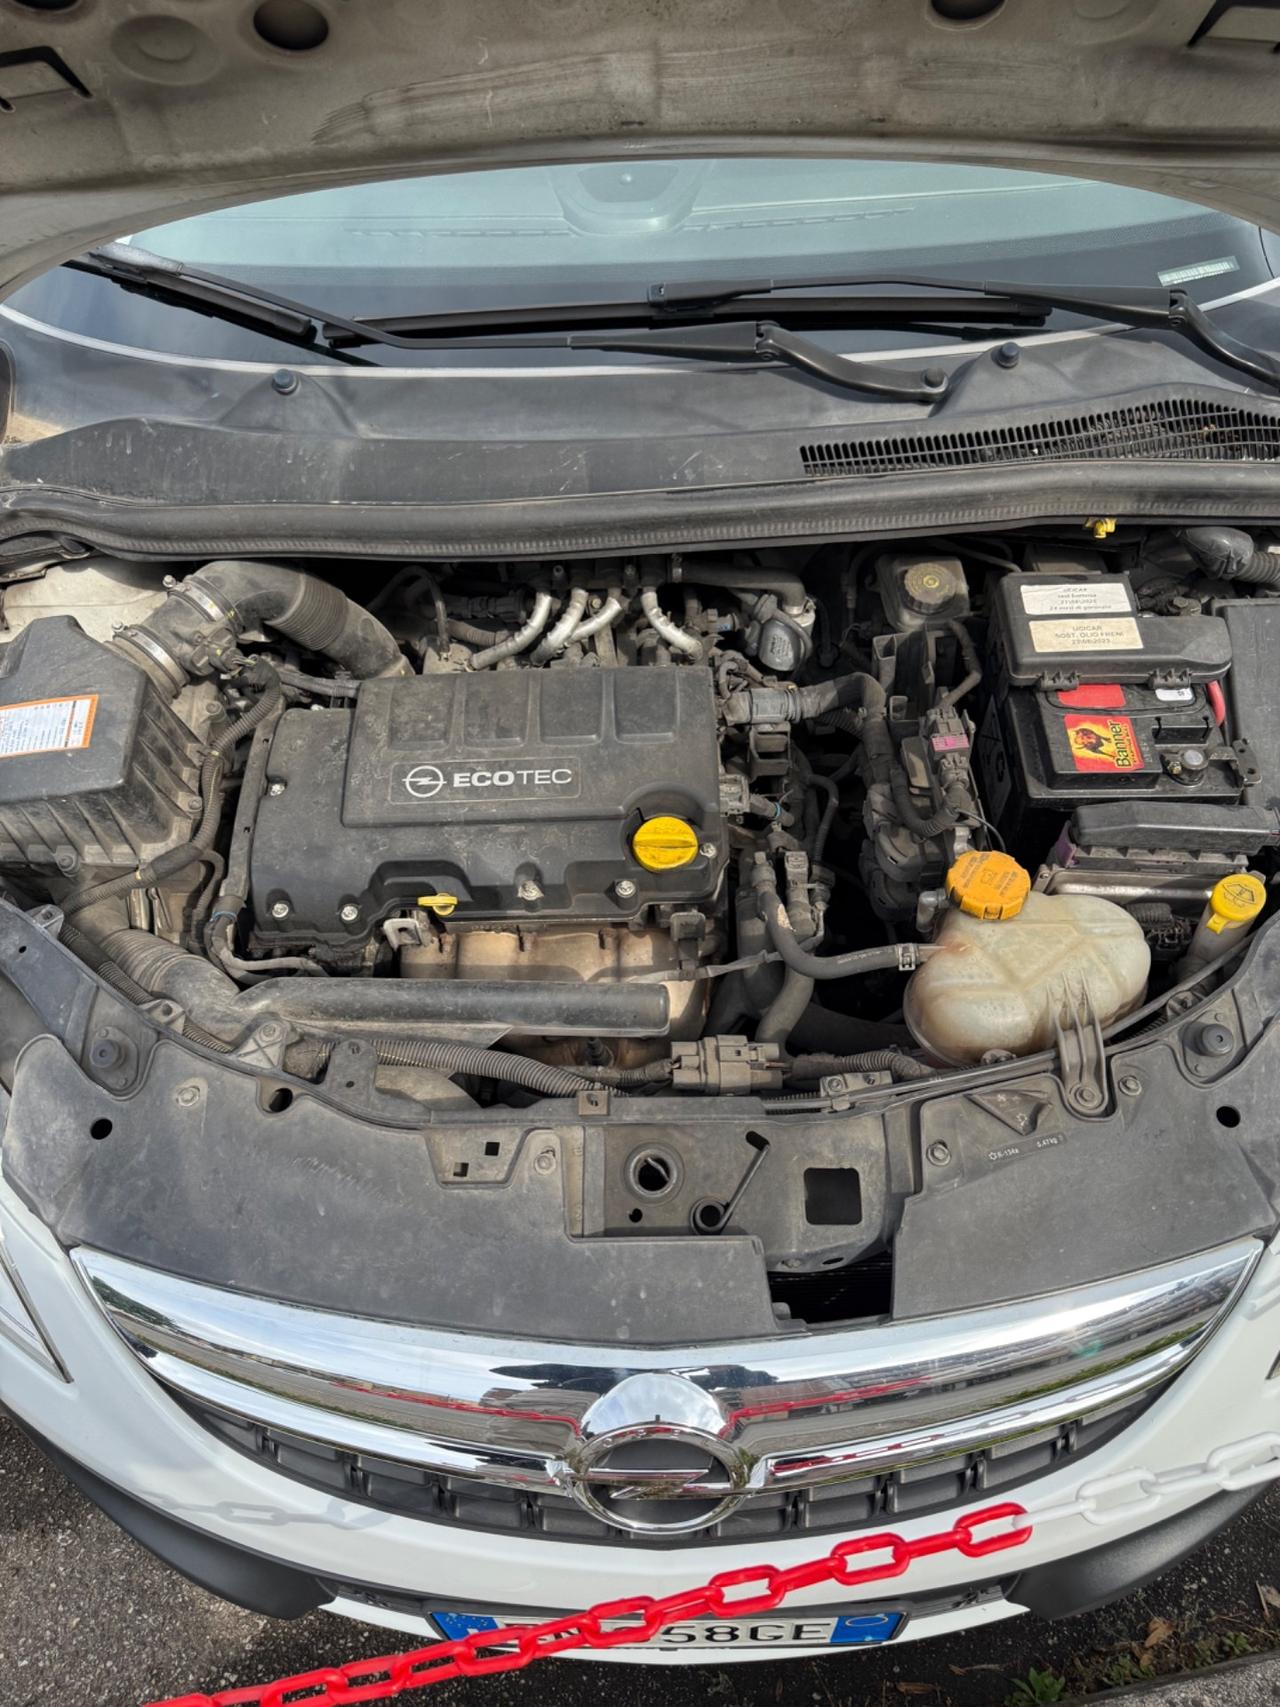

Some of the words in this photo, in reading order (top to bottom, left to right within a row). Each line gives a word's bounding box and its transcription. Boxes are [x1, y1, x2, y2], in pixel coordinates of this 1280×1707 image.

[1110, 721, 1133, 767] Banner
[453, 768, 573, 788] ECOTEC
[612, 1623, 831, 1644] 58GE
